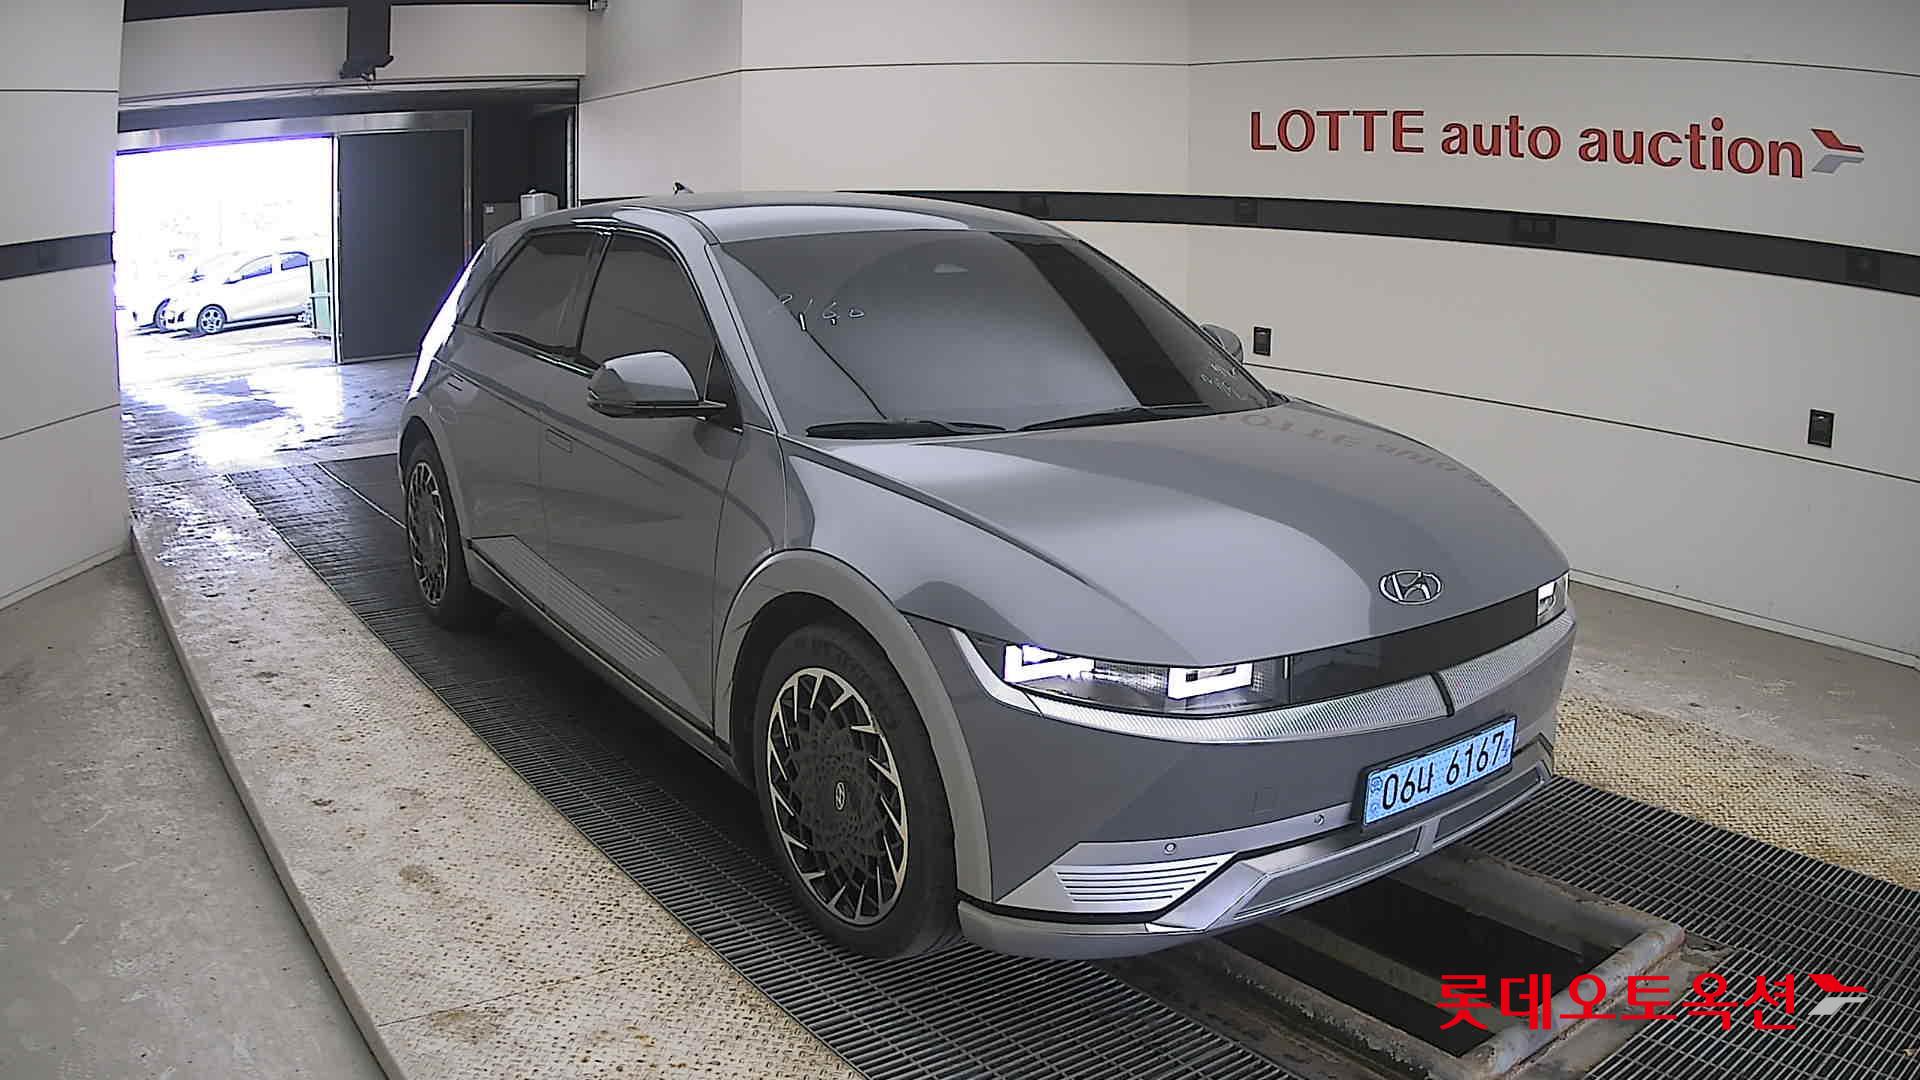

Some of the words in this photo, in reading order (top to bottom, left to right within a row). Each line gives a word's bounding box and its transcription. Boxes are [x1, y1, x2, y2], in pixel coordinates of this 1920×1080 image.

[1250, 110, 1424, 154] LOTTE
[1440, 116, 1562, 160] auto
[1577, 117, 1804, 178] auction
[1446, 730, 1505, 785] 6167
